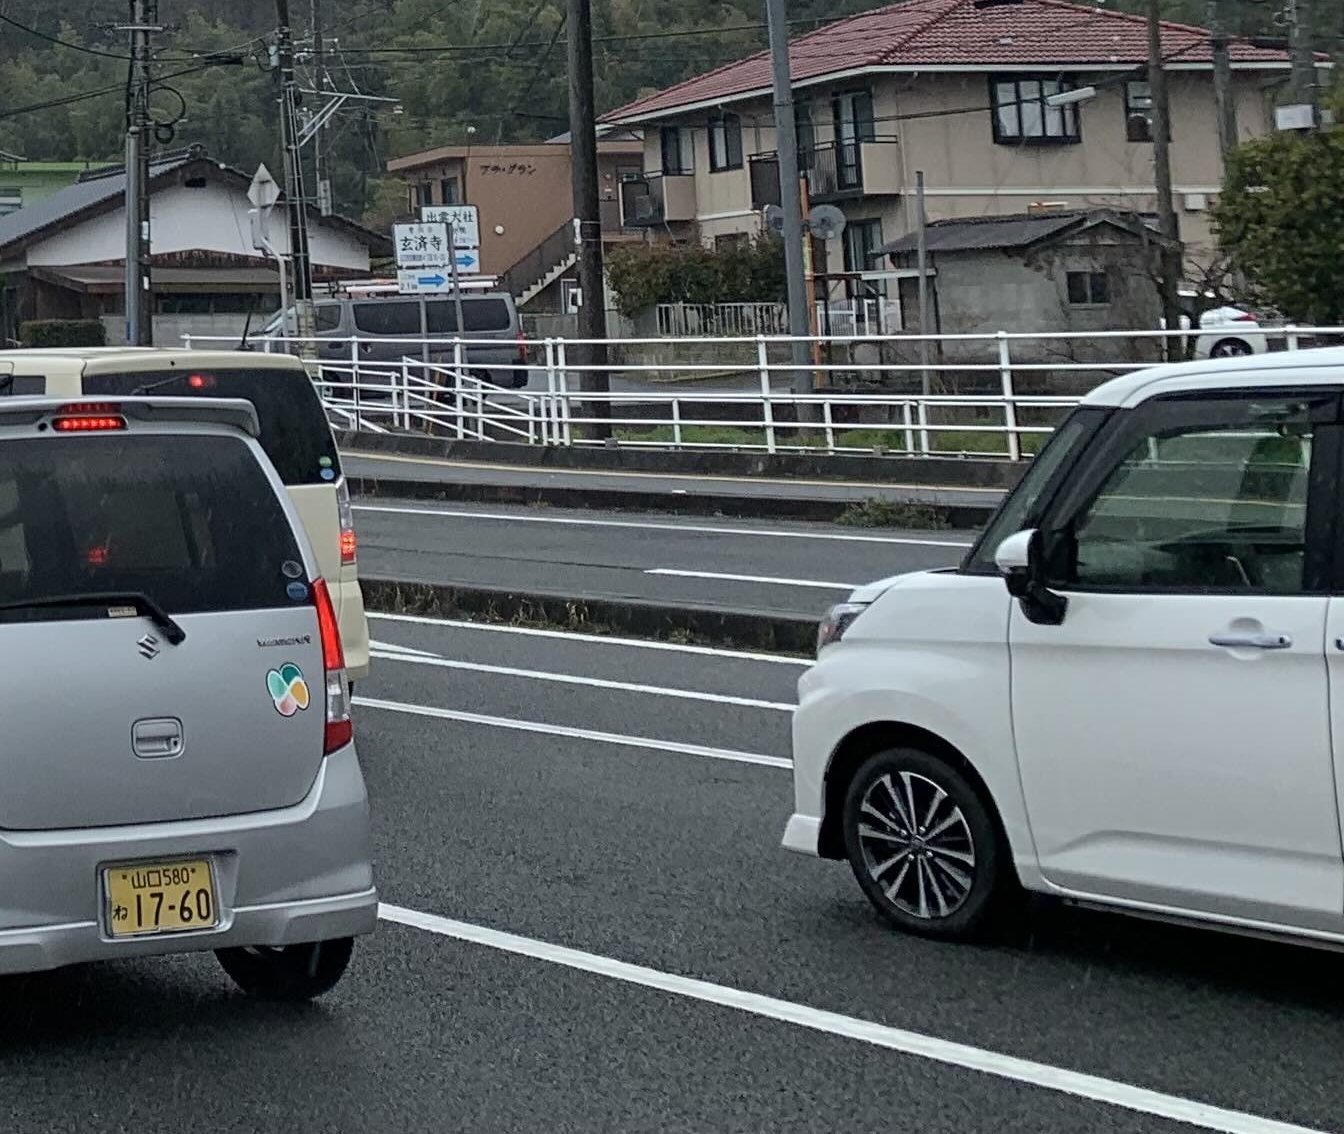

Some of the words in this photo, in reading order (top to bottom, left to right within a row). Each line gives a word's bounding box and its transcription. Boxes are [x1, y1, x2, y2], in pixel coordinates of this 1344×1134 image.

[399, 235, 442, 252] 玄済寺
[131, 867, 190, 889] 山口580
[136, 888, 211, 927] 17-60
